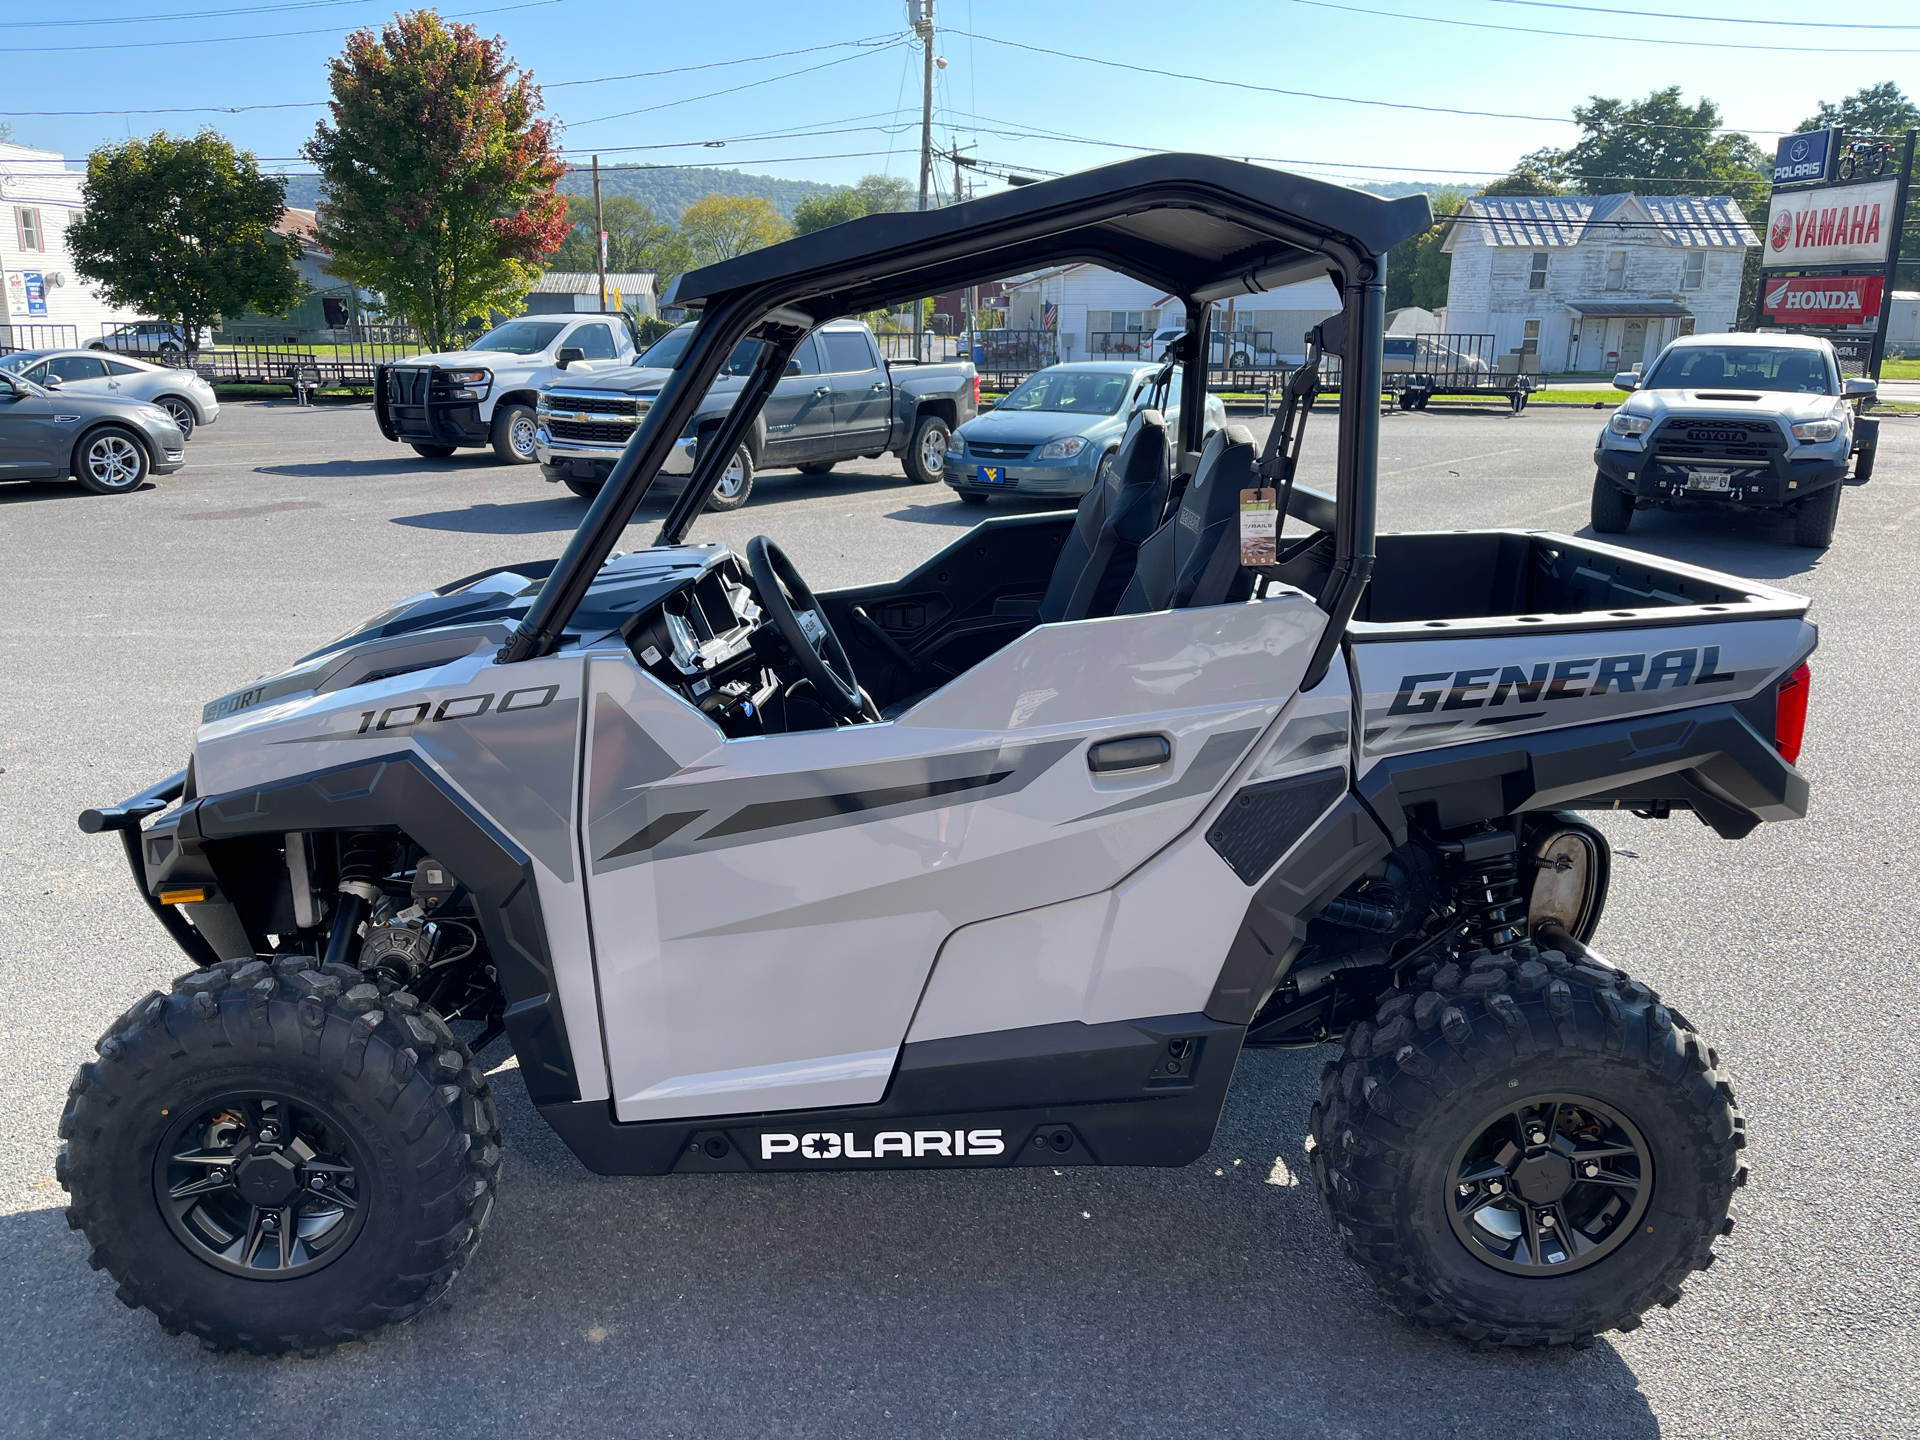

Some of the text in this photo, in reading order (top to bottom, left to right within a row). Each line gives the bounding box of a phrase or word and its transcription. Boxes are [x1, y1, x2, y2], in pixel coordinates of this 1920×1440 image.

[1774, 162, 1820, 180] POLARIS
[1795, 203, 1880, 248] YAMAHA
[1785, 290, 1861, 309] HONDA
[1691, 431, 1743, 441] TOYOTA
[1386, 645, 1735, 716] GENERAL
[205, 686, 266, 722] SPORT
[357, 684, 560, 735] 1000
[761, 1129, 1005, 1160] POLARIS
